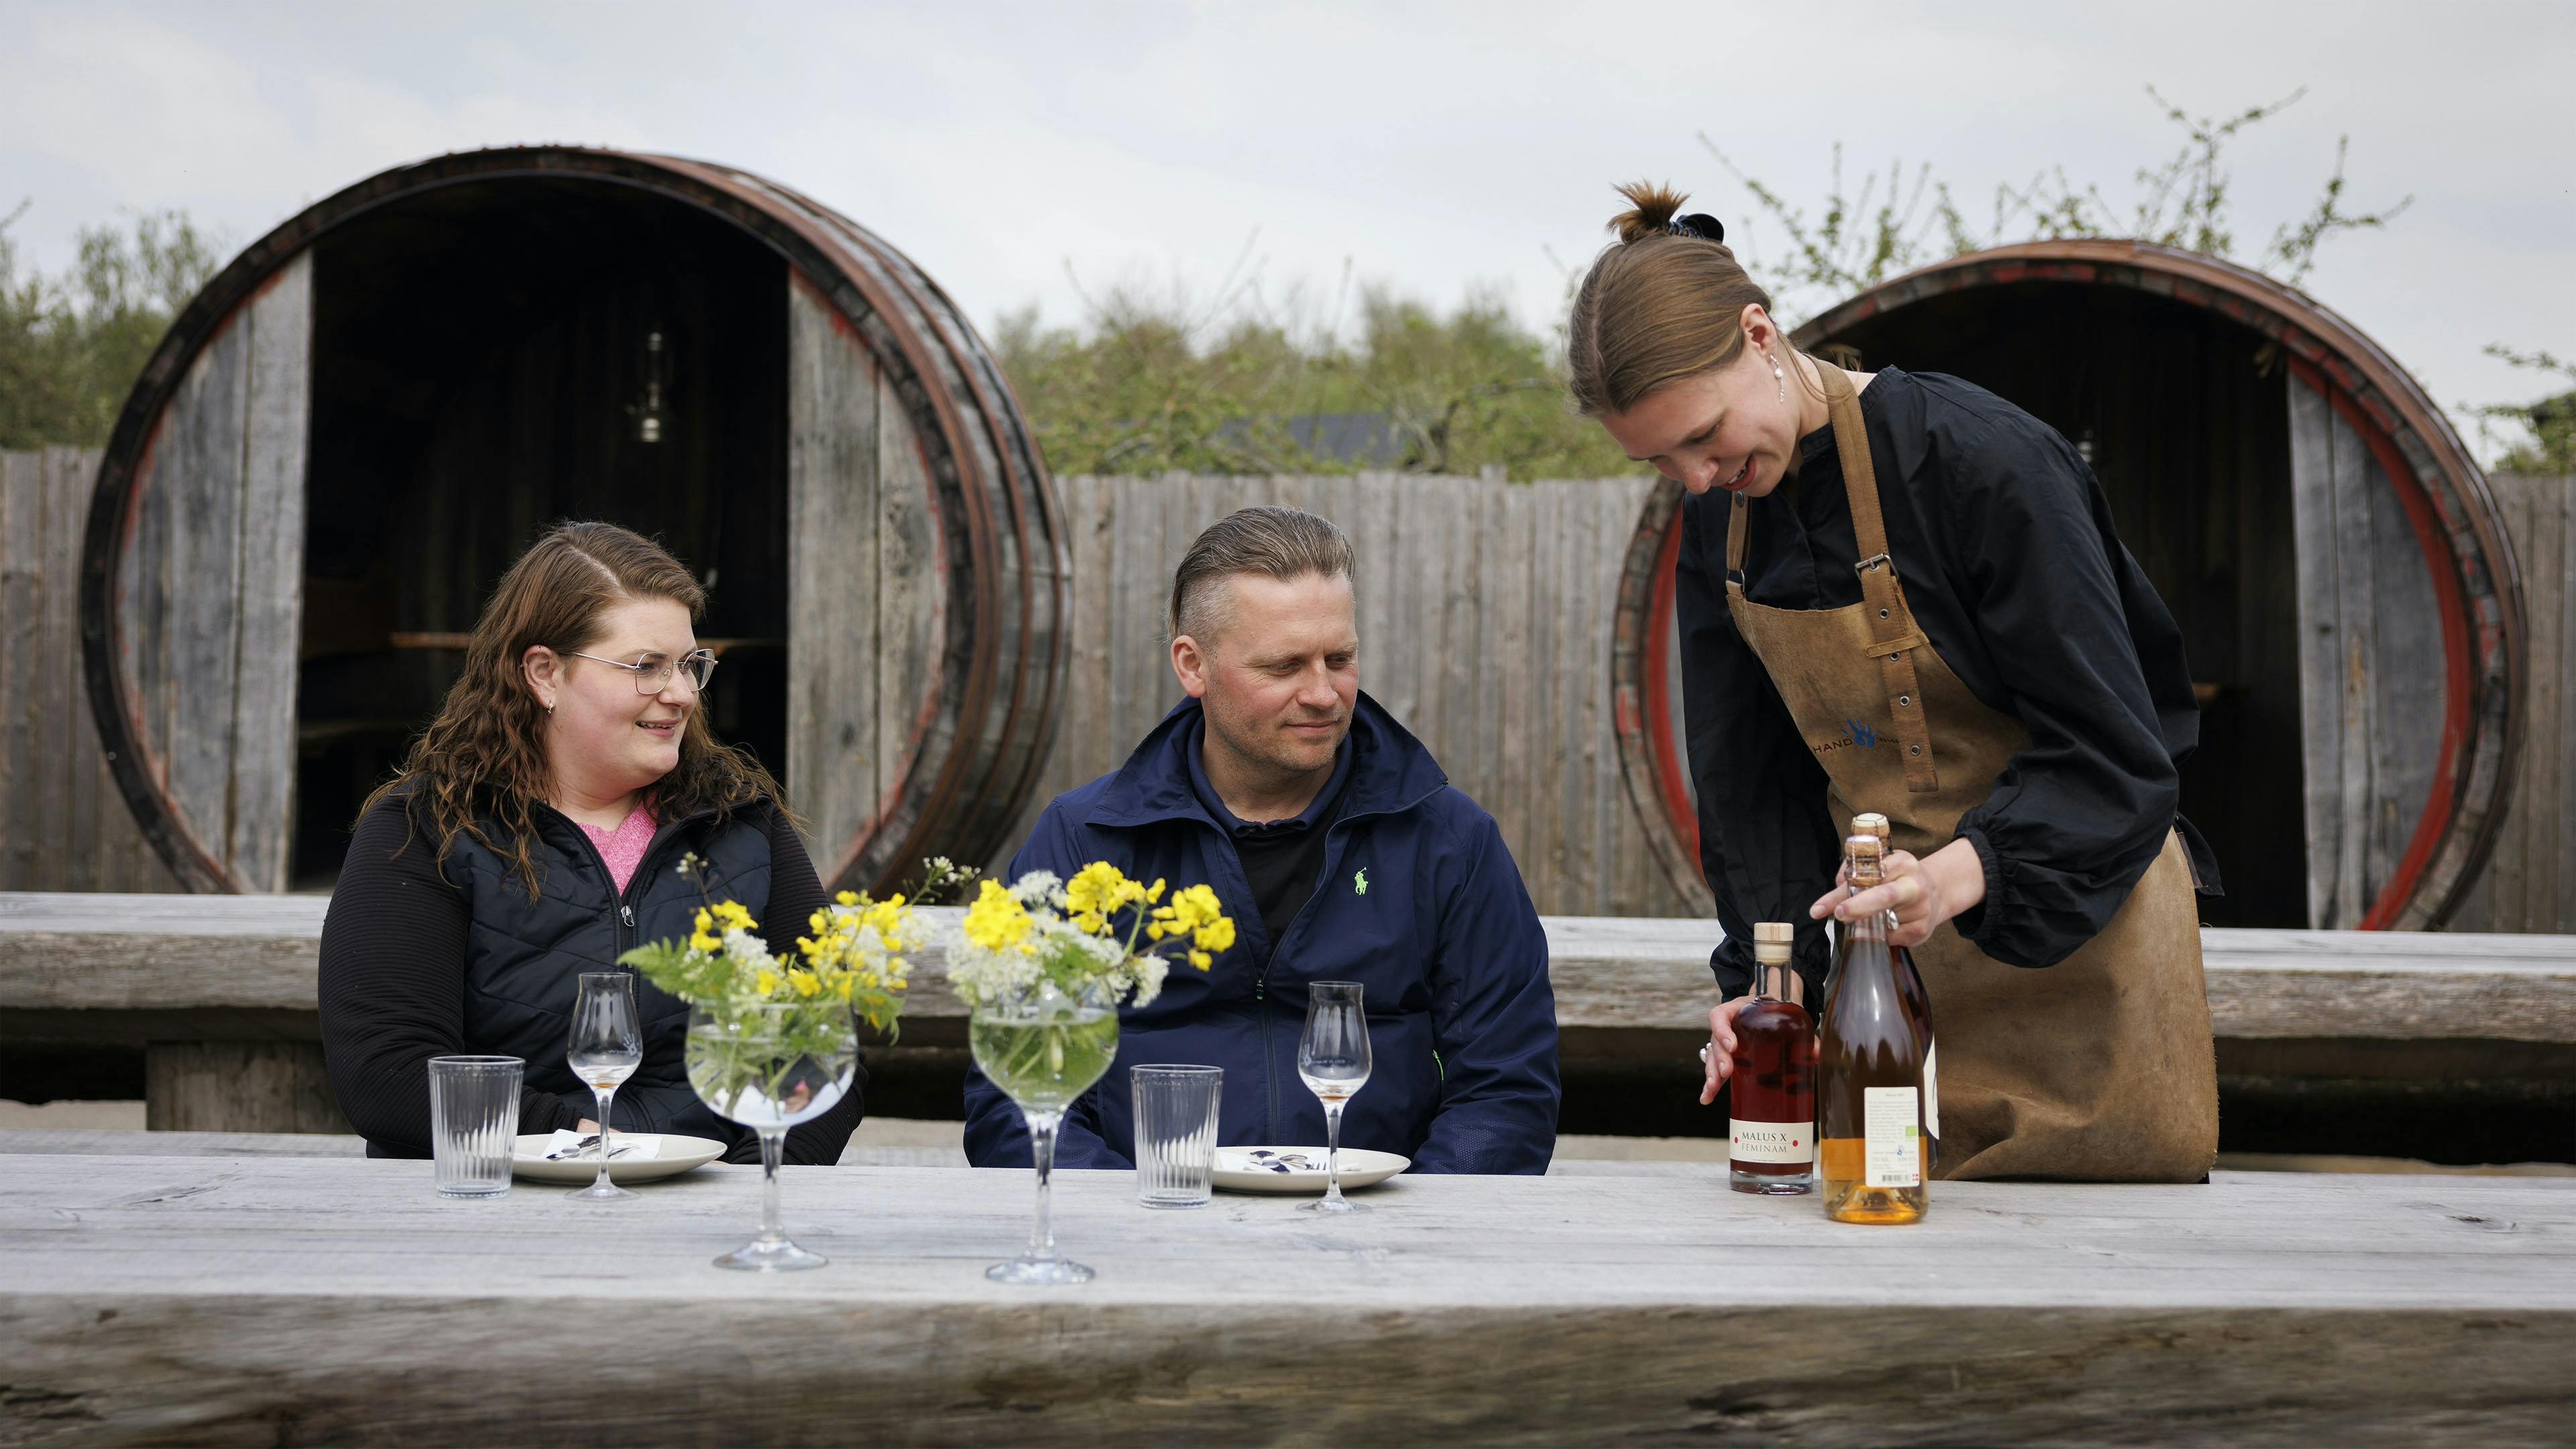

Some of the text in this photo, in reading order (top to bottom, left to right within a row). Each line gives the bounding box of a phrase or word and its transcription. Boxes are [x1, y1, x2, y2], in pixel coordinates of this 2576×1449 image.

[1813, 738, 1853, 754] HAND
[1742, 1132, 1786, 1142] MALUS X
[1741, 1142, 1787, 1153] FEMINAM
